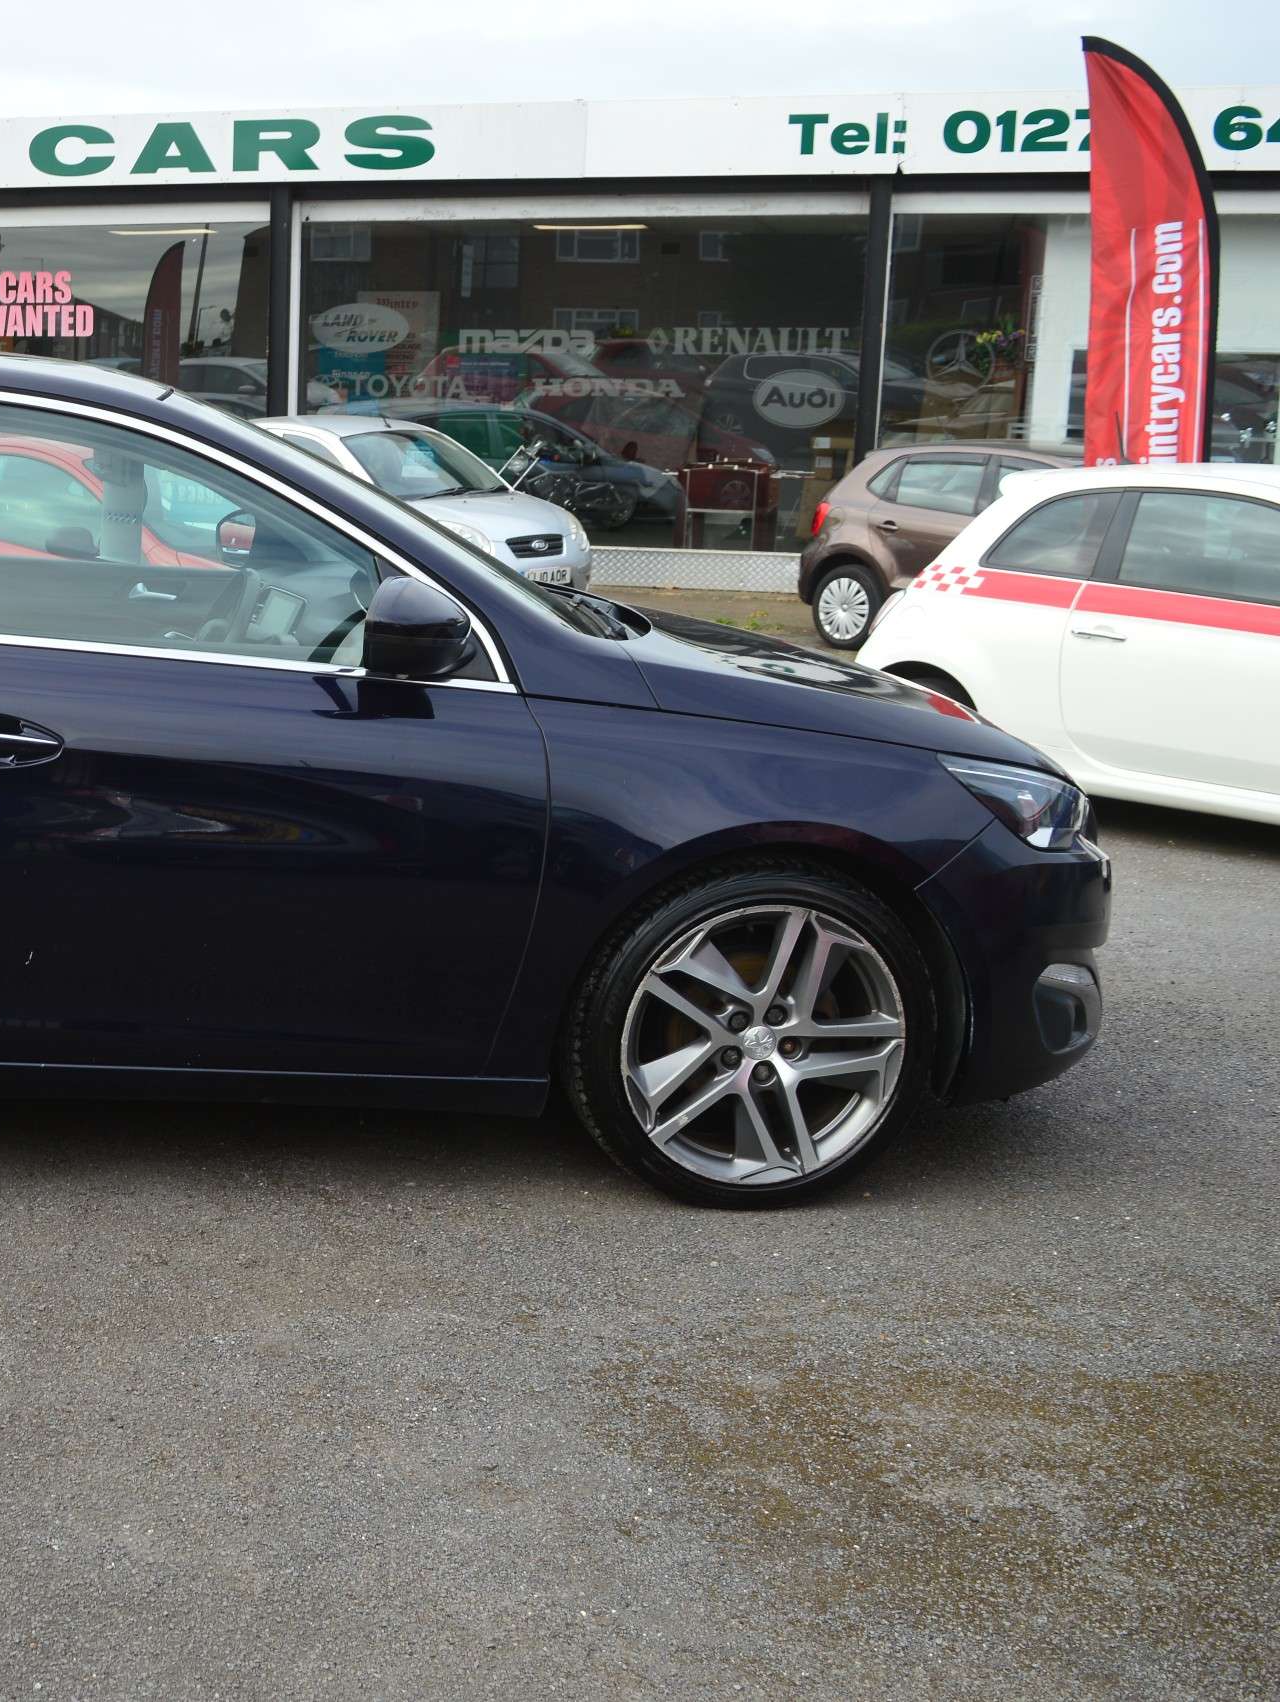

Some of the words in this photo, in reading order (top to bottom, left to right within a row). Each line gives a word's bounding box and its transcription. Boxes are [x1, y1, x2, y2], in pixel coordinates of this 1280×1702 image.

[787, 112, 907, 155] Tel:
[1213, 105, 1280, 151] 6
[28, 115, 436, 176] CARS
[322, 313, 365, 328] LAND
[346, 328, 399, 343] ROVER
[672, 327, 850, 355] RENAULT
[352, 374, 466, 398] TOYOTA
[532, 378, 686, 398] HONDA
